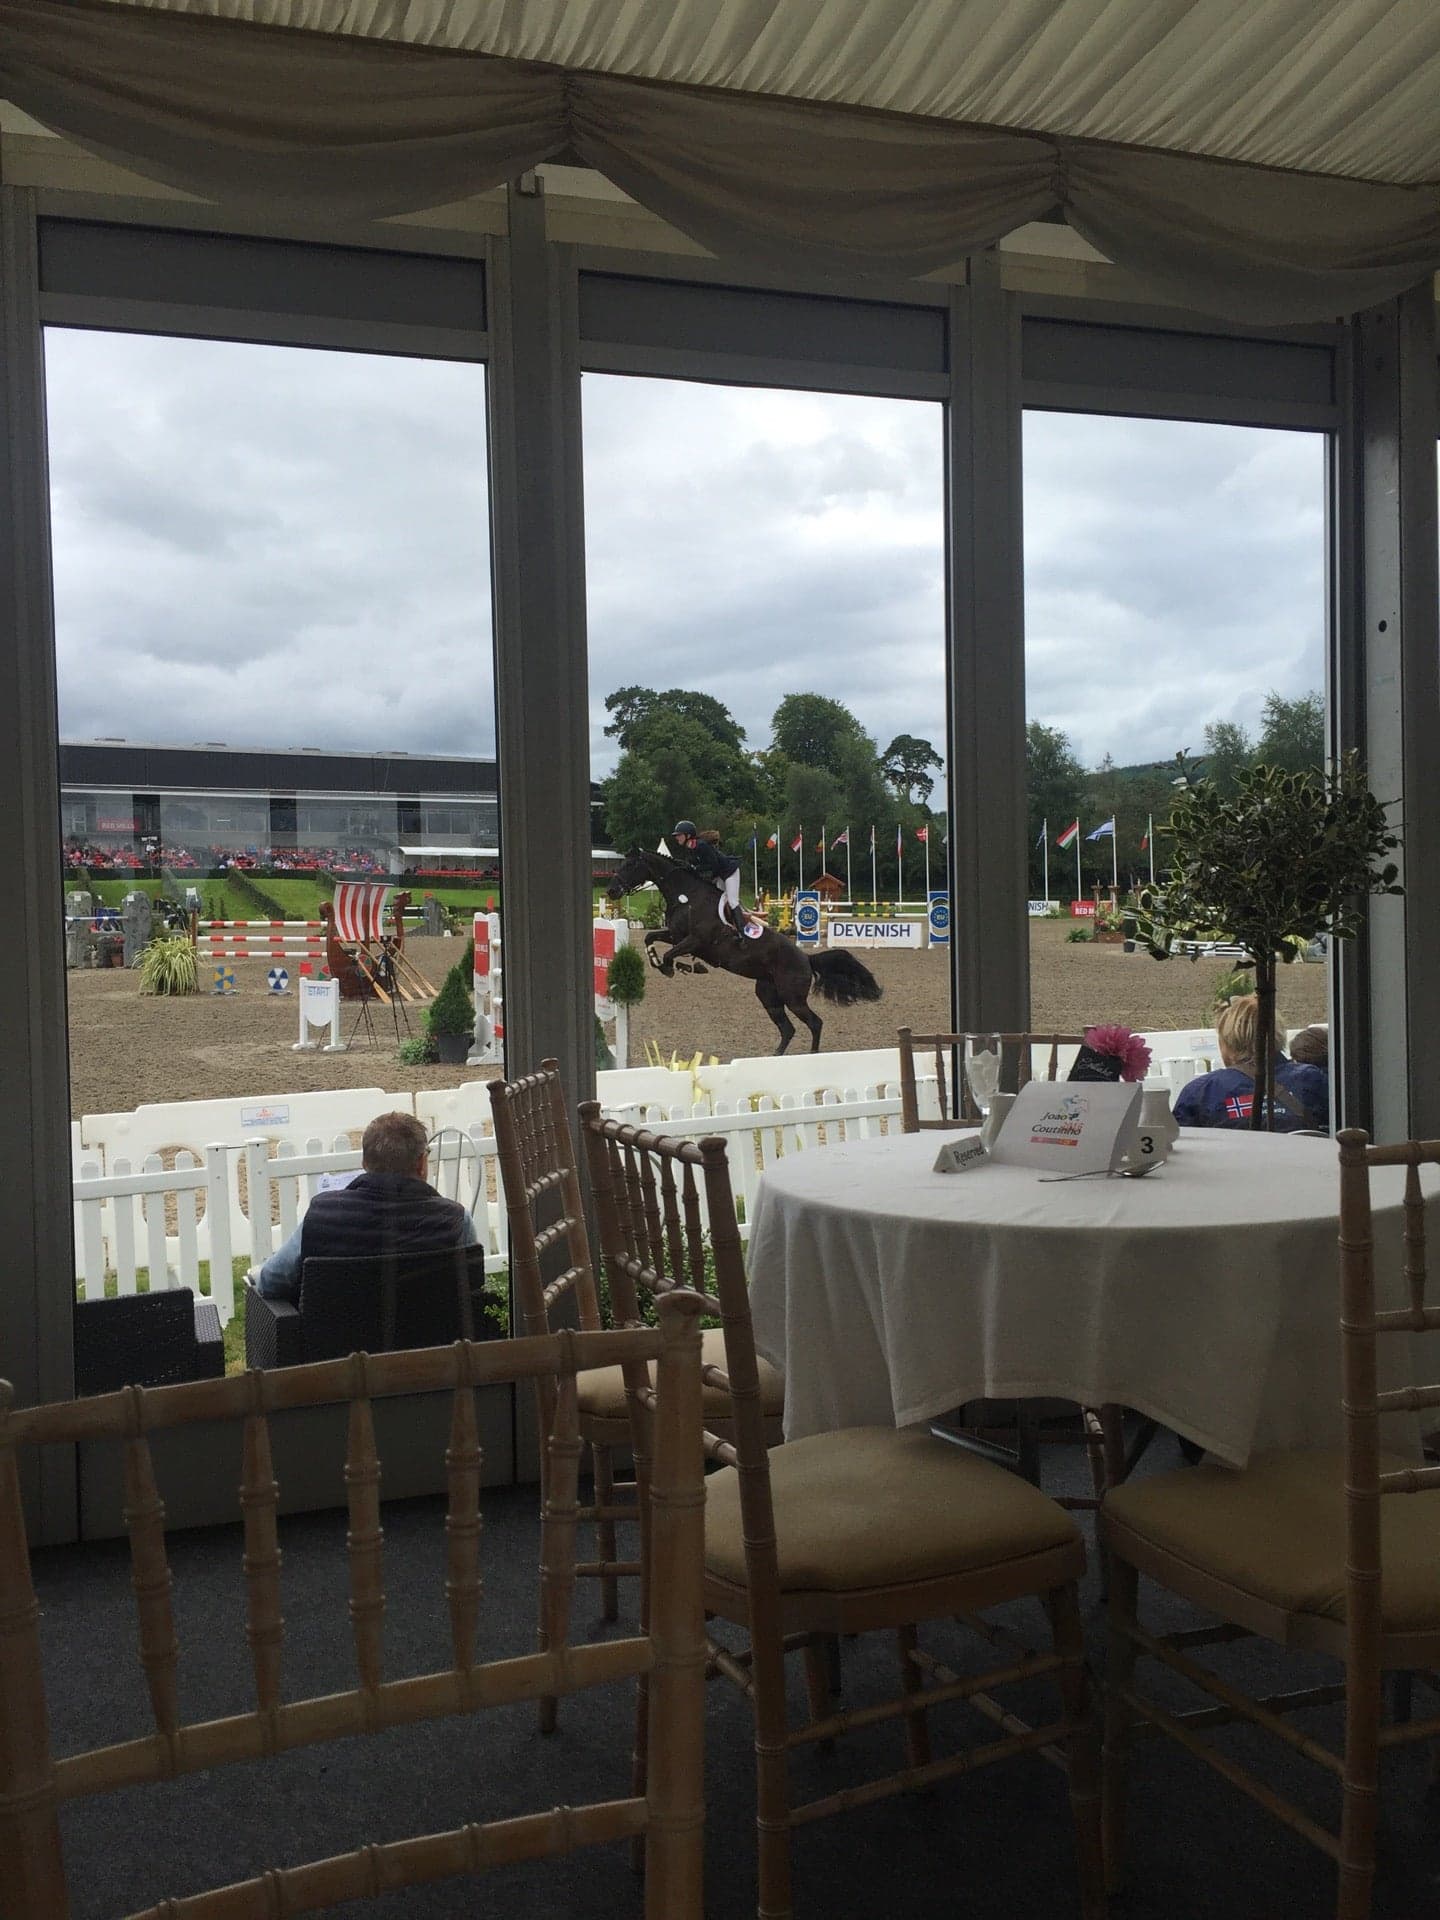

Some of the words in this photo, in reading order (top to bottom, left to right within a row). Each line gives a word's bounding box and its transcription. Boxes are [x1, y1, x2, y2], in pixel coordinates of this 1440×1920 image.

[833, 923, 911, 938] DEVENISH
[308, 986, 329, 997] START
[1031, 1123, 1082, 1136] Coutinho
[1140, 1136, 1154, 1154] 3
